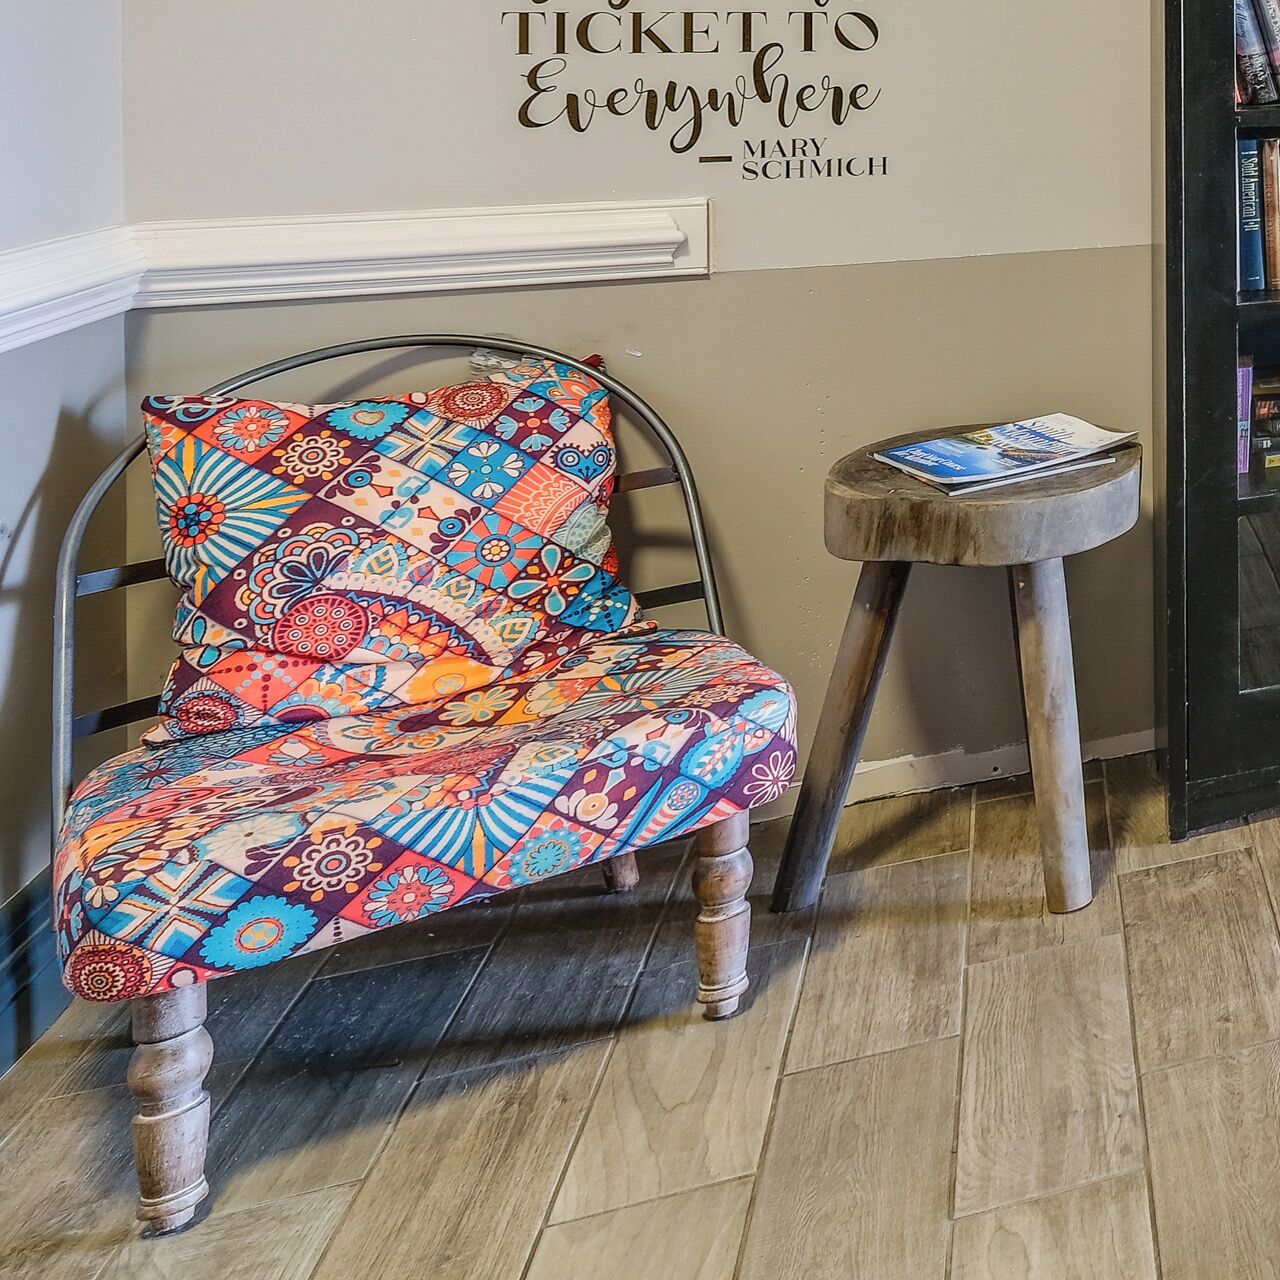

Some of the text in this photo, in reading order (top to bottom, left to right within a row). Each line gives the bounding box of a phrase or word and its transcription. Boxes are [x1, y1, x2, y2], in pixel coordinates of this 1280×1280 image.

[501, 11, 879, 54] TICKET TO
[518, 43, 881, 153] Everywhere
[743, 138, 828, 159] MARY
[742, 157, 888, 181] SCHMICH
[1242, 158, 1258, 176] Sold
[1242, 178, 1259, 218] American
